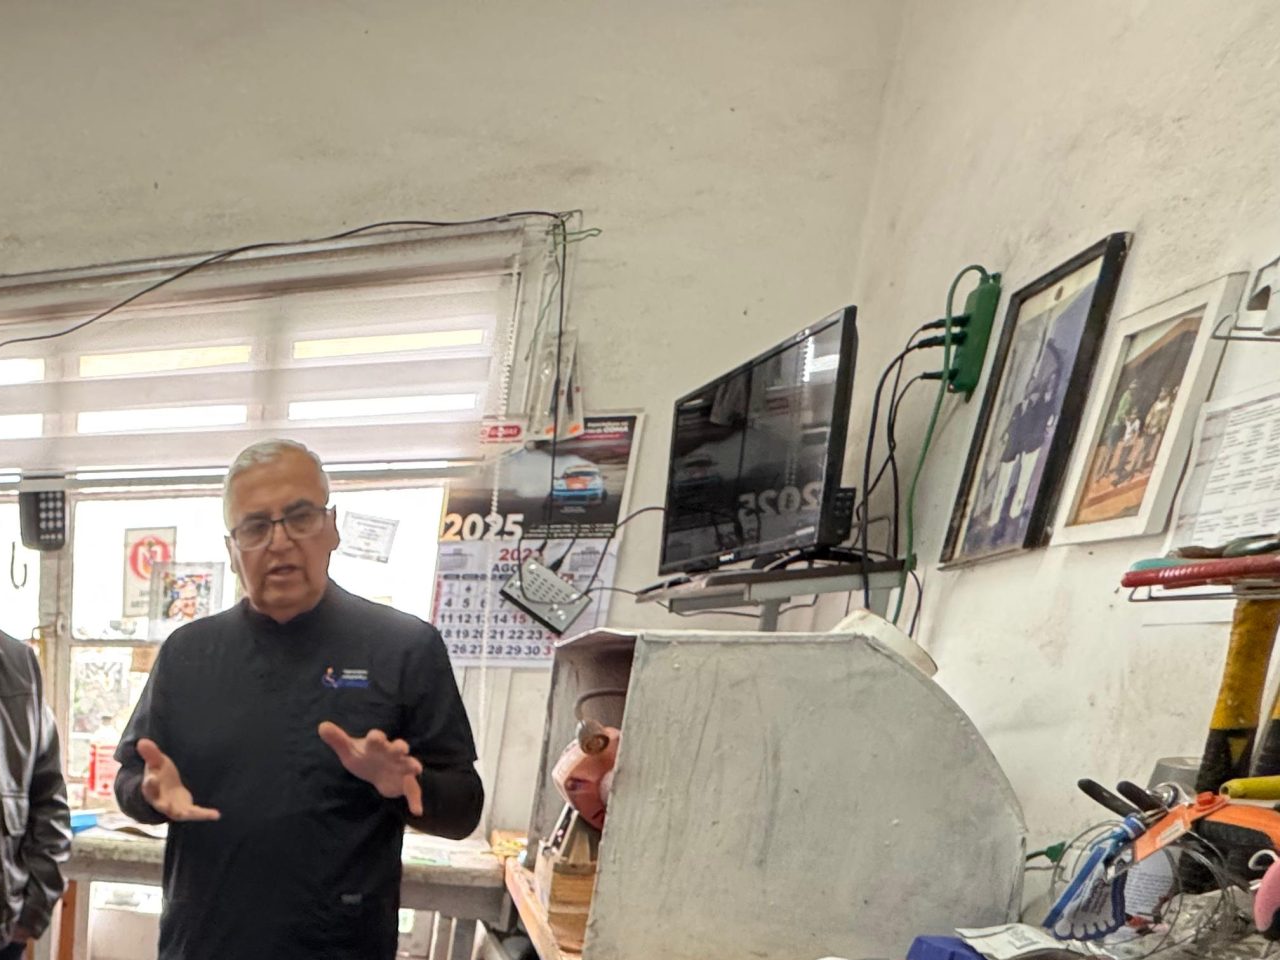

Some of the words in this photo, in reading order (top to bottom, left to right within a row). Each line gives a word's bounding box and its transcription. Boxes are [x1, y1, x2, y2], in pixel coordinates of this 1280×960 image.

[440, 512, 524, 541] 2025
[492, 563, 519, 573] AGO
[444, 598, 452, 608] 4
[462, 598, 470, 608] 5
[441, 614, 453, 623] 11
[457, 614, 472, 623] 12
[493, 614, 507, 624] 14
[512, 614, 527, 624] 15
[456, 629, 470, 639] 19
[489, 630, 505, 640] 21
[508, 630, 524, 640] 22
[526, 630, 543, 640] 23
[452, 644, 467, 654] 26
[488, 645, 503, 655] 28
[505, 645, 522, 655] 29
[524, 645, 540, 656] 30
